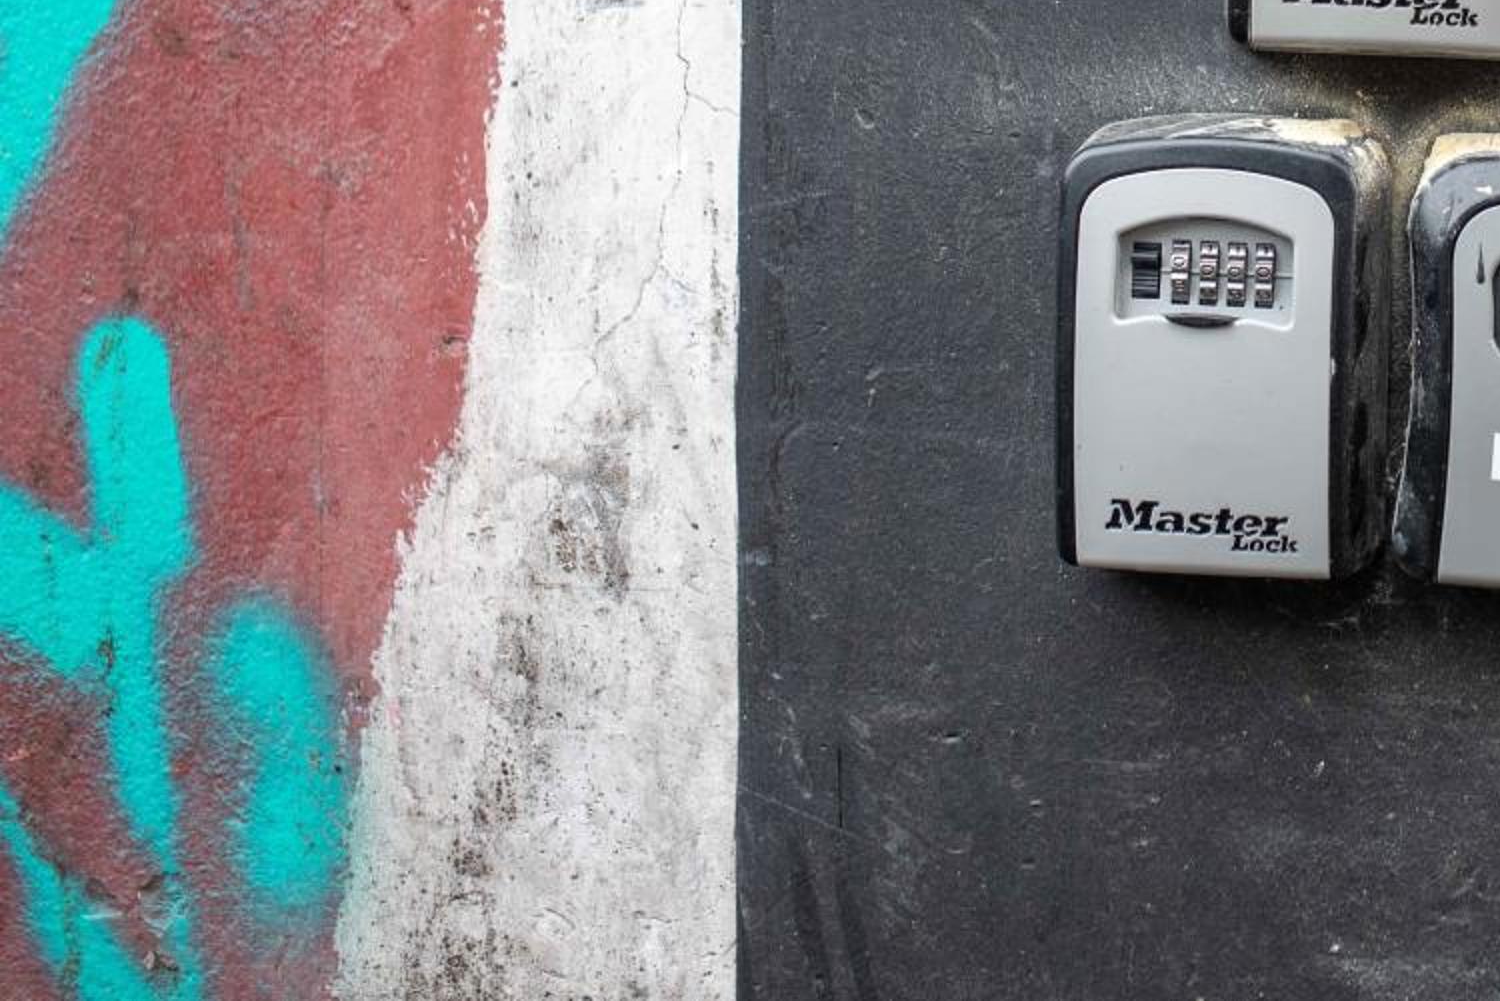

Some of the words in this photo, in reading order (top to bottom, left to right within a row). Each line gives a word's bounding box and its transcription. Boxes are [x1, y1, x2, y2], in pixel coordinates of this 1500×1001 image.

[1409, 6, 1480, 28] Lock
[1105, 498, 1289, 537] Master
[1231, 533, 1299, 553] Lock
